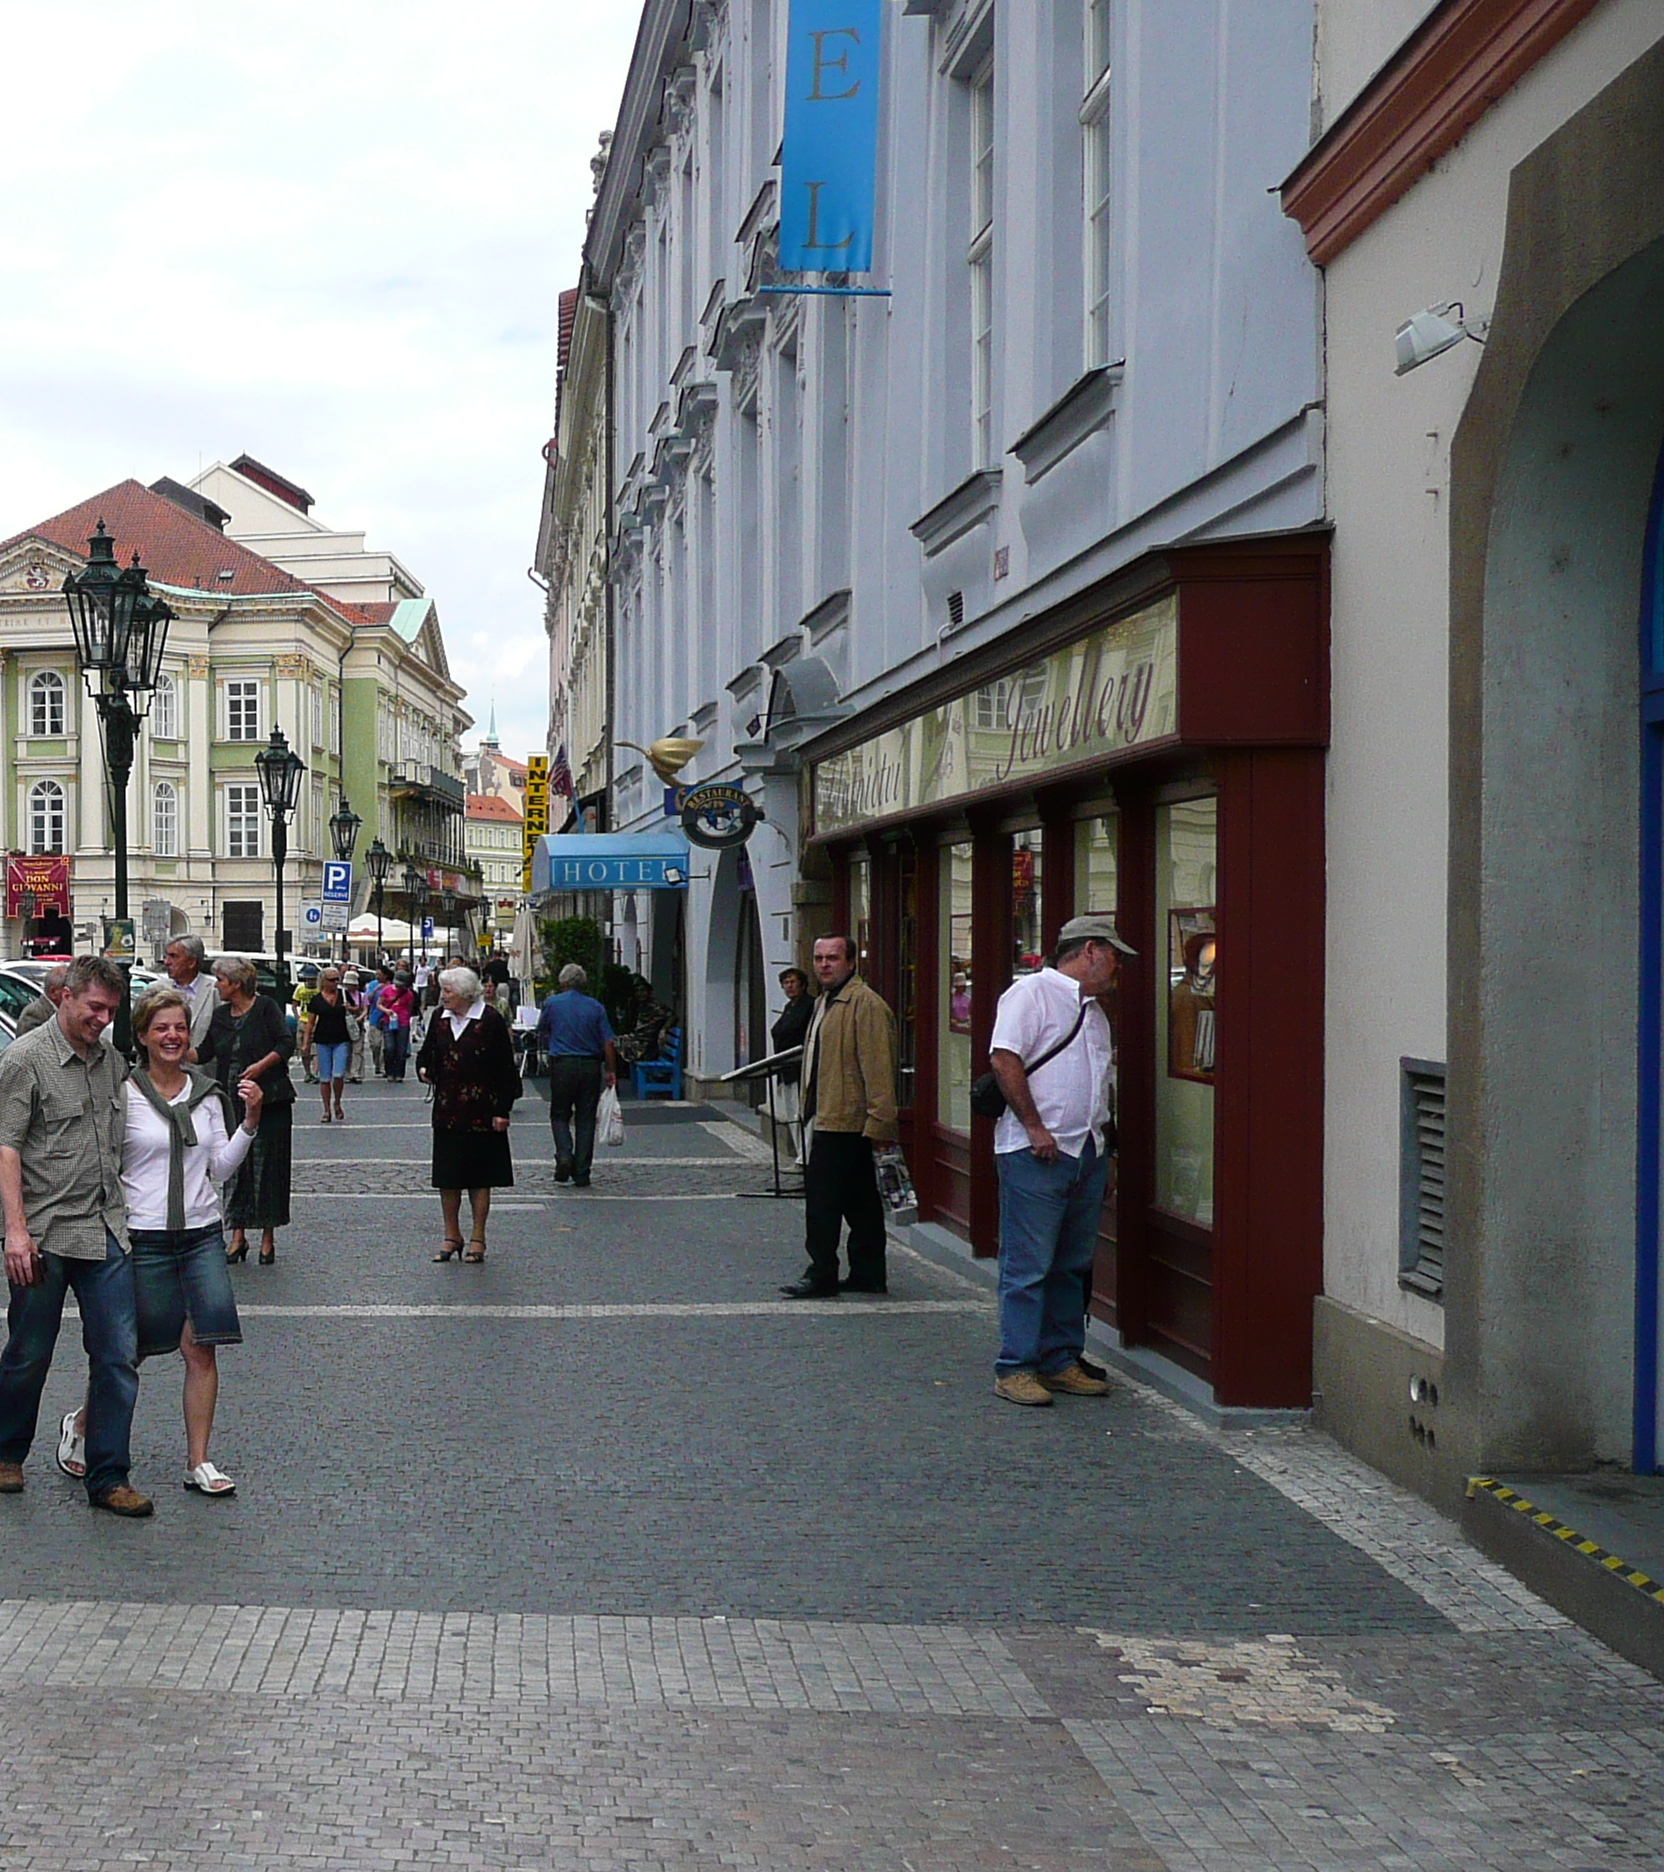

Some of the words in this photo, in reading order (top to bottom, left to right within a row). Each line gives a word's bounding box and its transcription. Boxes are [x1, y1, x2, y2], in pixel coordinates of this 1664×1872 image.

[996, 640, 1154, 780] Jewellery
[26, 875, 50, 883] DON
[328, 866, 346, 890] P
[12, 883, 64, 892] GIOVANNI
